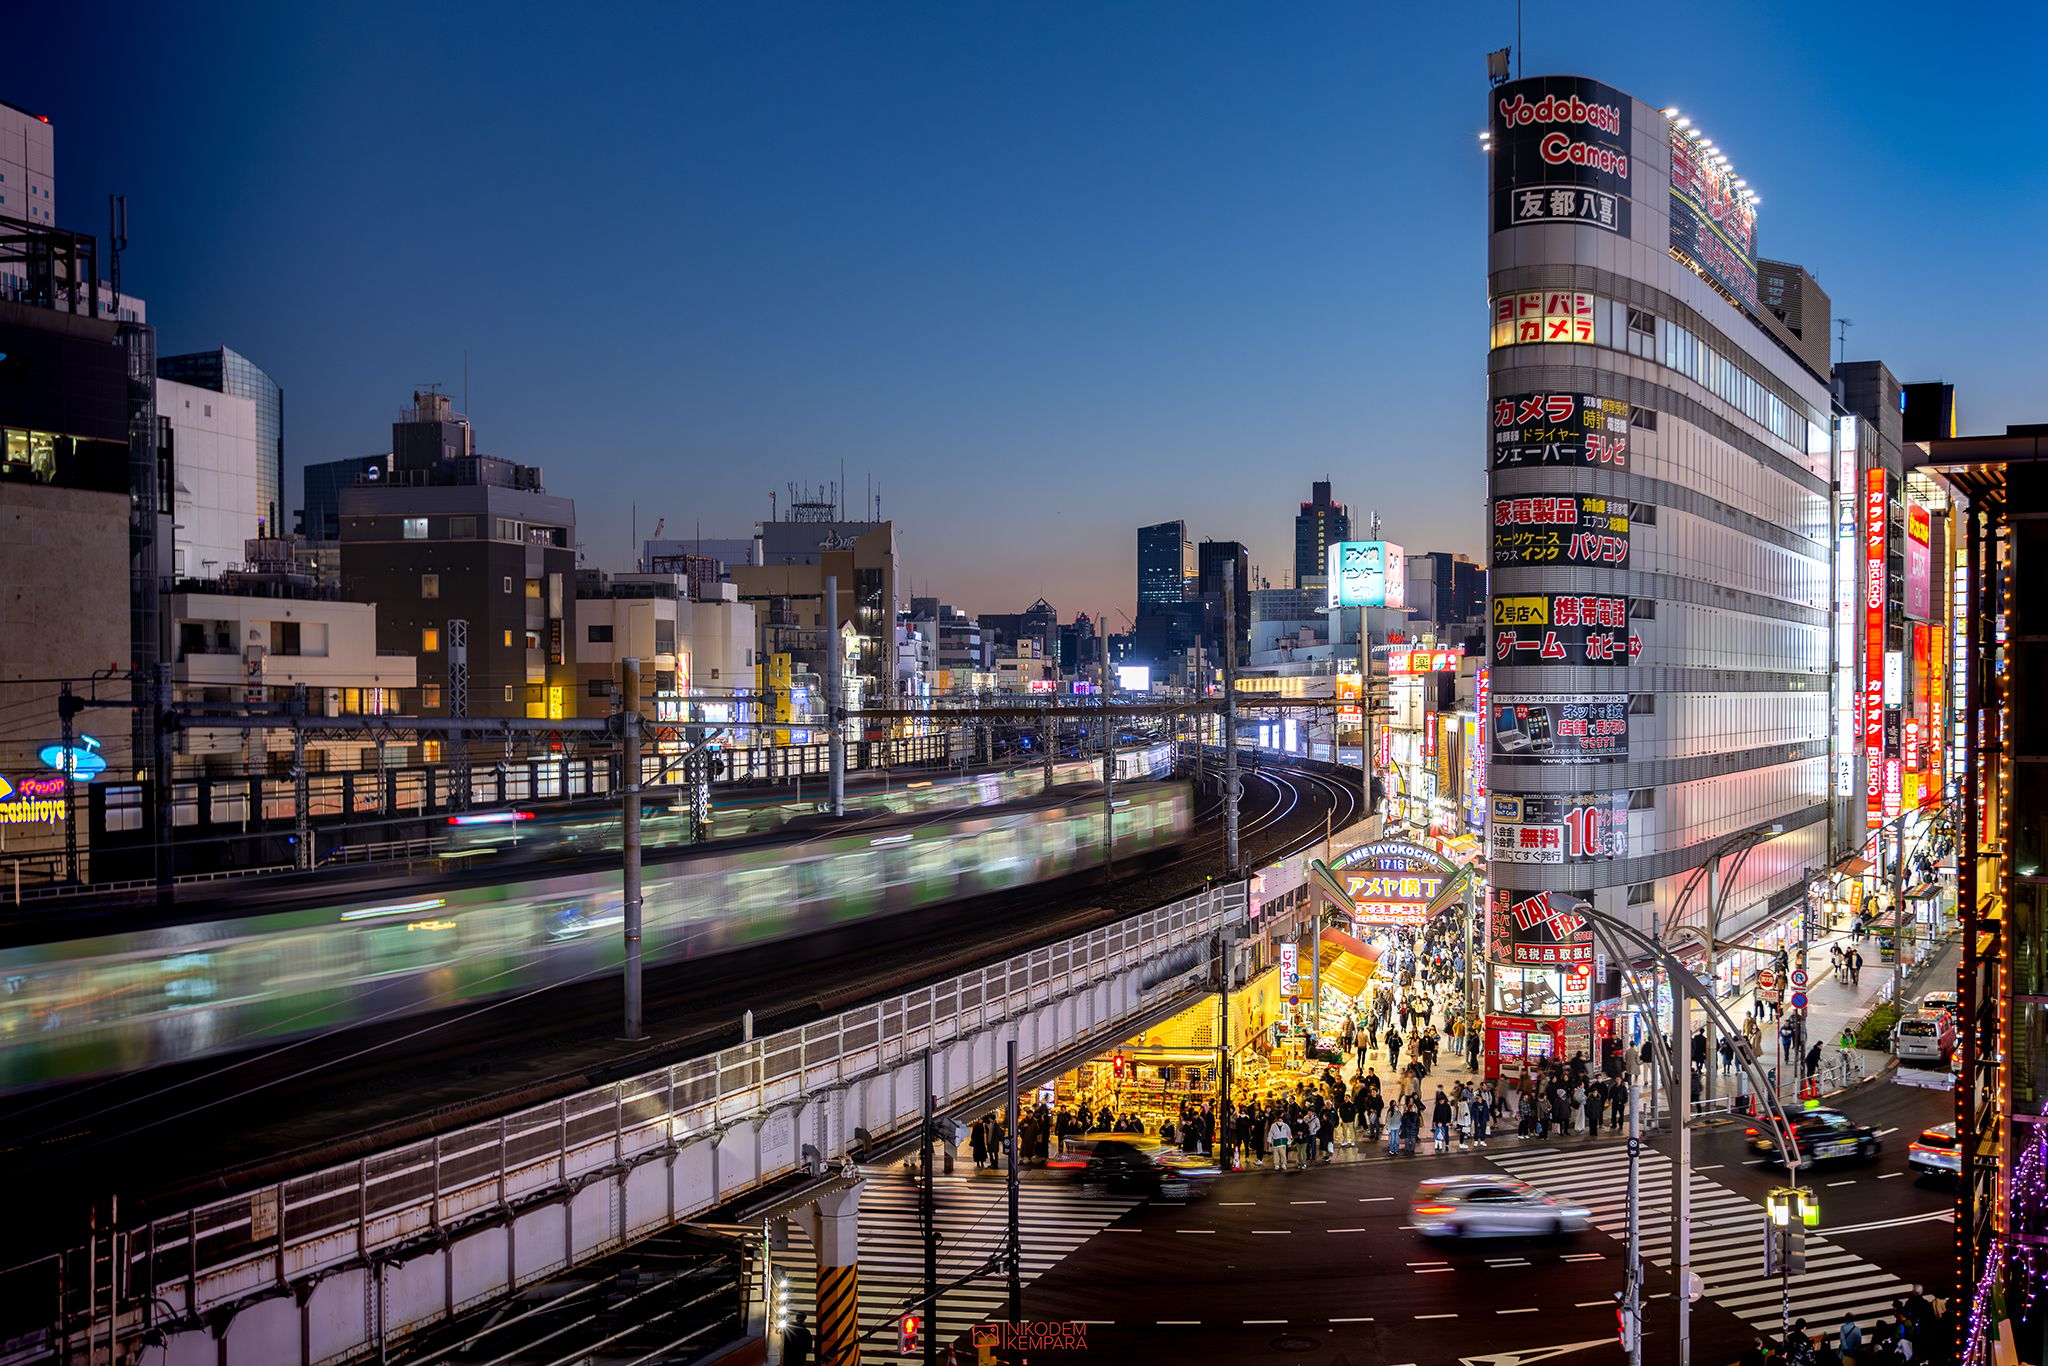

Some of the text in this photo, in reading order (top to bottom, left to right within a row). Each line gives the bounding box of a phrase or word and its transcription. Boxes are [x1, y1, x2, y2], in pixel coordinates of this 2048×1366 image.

[1500, 93, 1620, 136] Yodobashi
[1540, 132, 1627, 179] Camera
[1520, 190, 1614, 225] 友都八喜
[1498, 294, 1592, 319] ヨドバシ
[1520, 319, 1592, 341] カメラ
[1495, 395, 1574, 427] カメラ
[1583, 410, 1605, 430] 時計
[1523, 428, 1580, 442] ドライヤー
[1496, 442, 1576, 463] シェーバー
[1585, 433, 1626, 465] テレビ
[1495, 498, 1577, 525] 家電製品
[1582, 515, 1609, 529] エアコン
[1868, 492, 1883, 547] カラオケ
[1495, 532, 1560, 547] スーツケース
[1568, 532, 1628, 563] パソコン
[1495, 546, 1559, 561] マウス インク
[1342, 567, 1383, 580] センター
[1868, 559, 1880, 608] BIG ECHO
[1495, 596, 1625, 627] 2号店へ 携帯電話
[1496, 631, 1566, 660] ゲーム
[1586, 633, 1625, 660] ホビー
[1563, 704, 1624, 718] ネットで注文
[1867, 680, 1882, 735] カラオケ
[1931, 702, 1942, 752] エスパス
[1867, 747, 1879, 796] BIG ECHO
[1494, 826, 1515, 837] 入会金
[1494, 828, 1560, 849] 年会費 無料
[1345, 844, 1439, 865] AMEYAYOKOCHO
[1347, 876, 1442, 898] アメヤ横丁
[1500, 890, 1510, 938] ヨドバシ
[1512, 890, 1562, 932] TAX
[1517, 947, 1592, 961] 免税品取扱店
